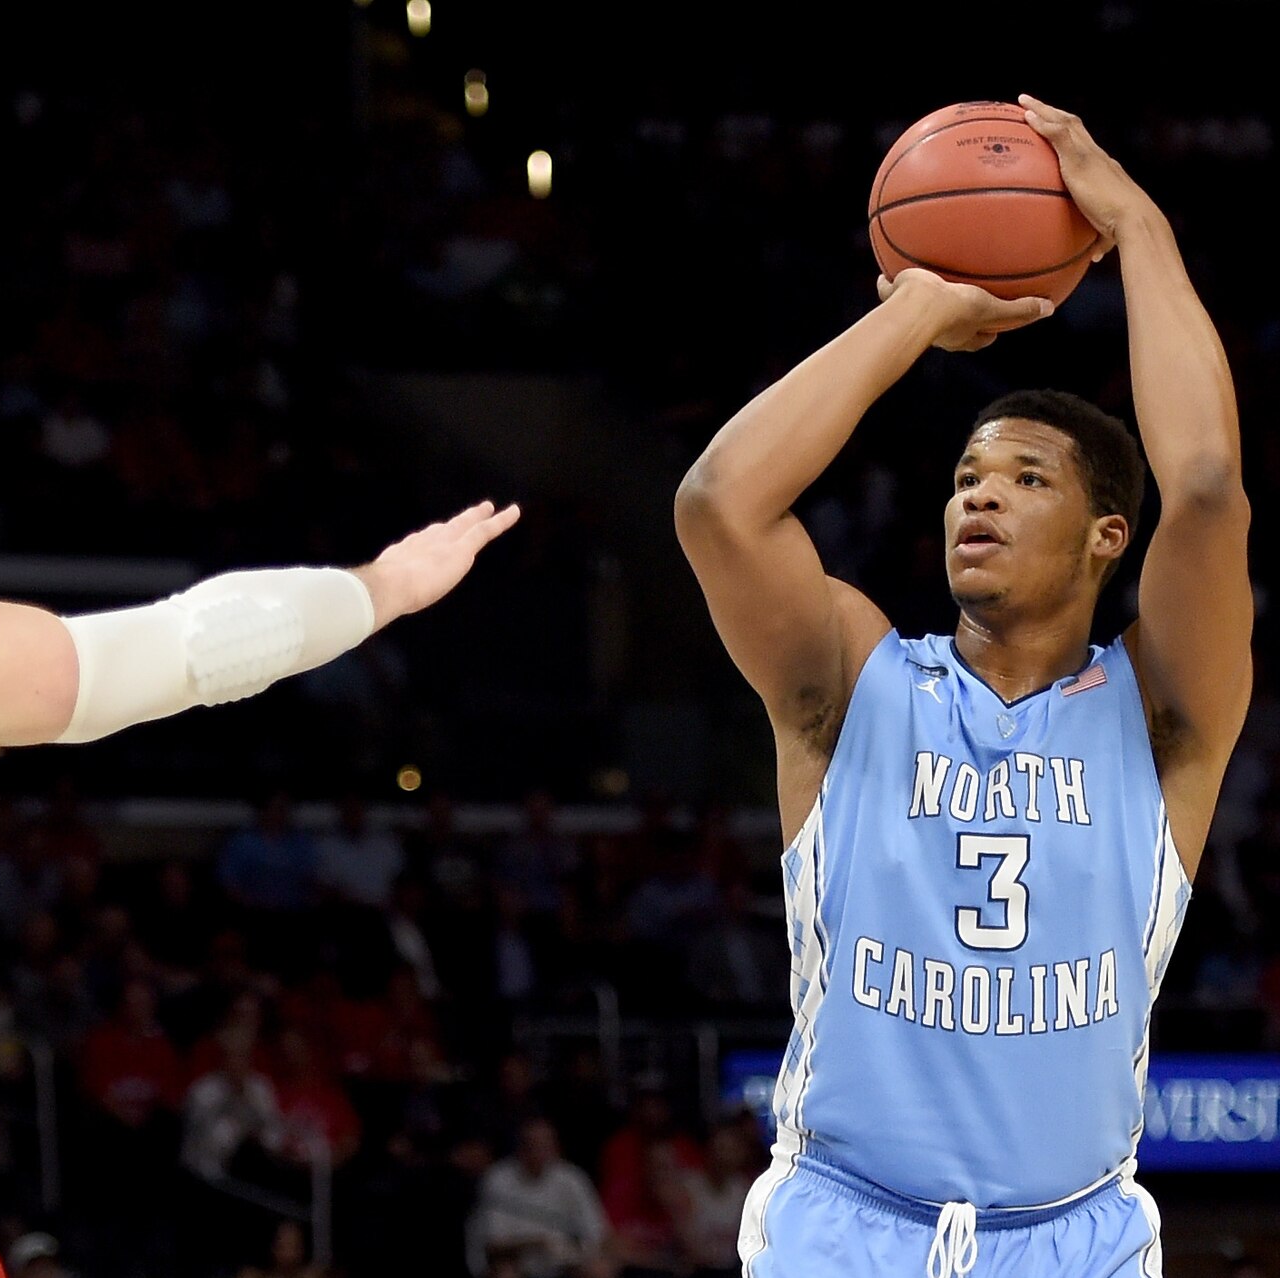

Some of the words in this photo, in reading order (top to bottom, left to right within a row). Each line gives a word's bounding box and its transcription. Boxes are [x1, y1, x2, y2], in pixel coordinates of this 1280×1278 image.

[956, 136, 984, 147] WEST
[907, 751, 1092, 826] NORTH
[954, 831, 1031, 952] 3
[852, 935, 1119, 1036] CAROLINA
